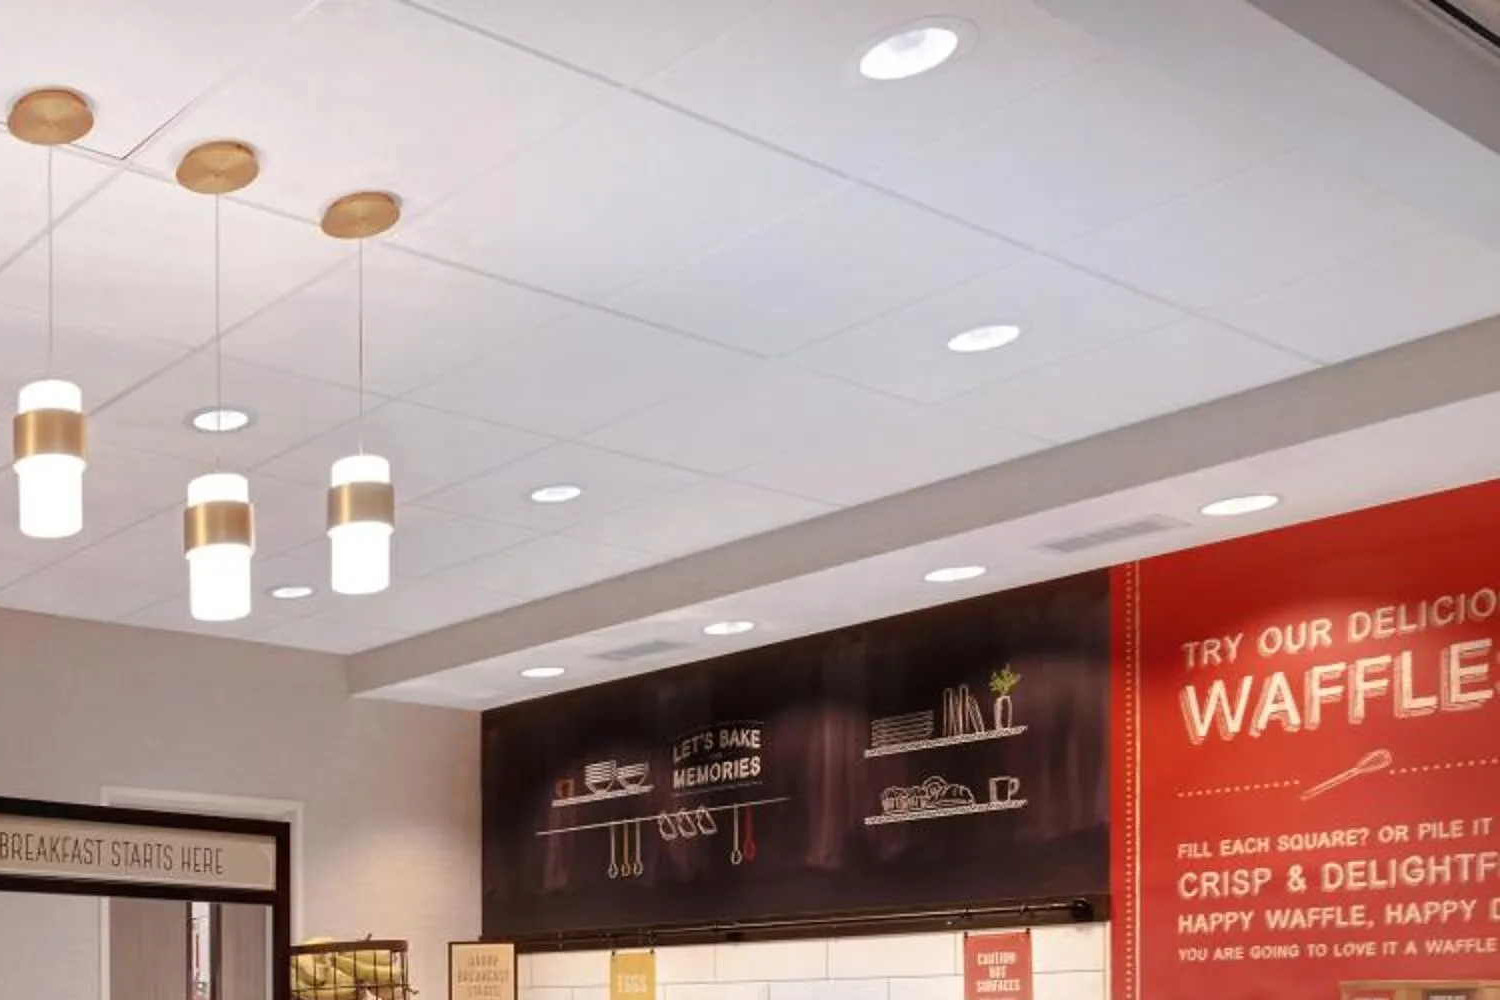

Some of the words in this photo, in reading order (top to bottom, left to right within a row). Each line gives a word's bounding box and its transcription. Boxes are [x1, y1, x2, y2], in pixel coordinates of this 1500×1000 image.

[1182, 632, 1244, 669] TRY
[1257, 618, 1332, 656] OUR
[1348, 587, 1500, 643] DELICIO
[1180, 637, 1500, 745] WAFFLE
[673, 732, 714, 763] LET'S
[720, 728, 761, 749] BAKE
[672, 756, 761, 789] MEMORIES
[0, 831, 105, 866] BREAKFAST
[111, 840, 173, 872] STARTS
[181, 846, 225, 876] HERE
[1178, 843, 1212, 859] FILL
[1220, 837, 1269, 856] EACH
[1277, 828, 1370, 851] SQUARE?
[1378, 824, 1409, 843] OR
[1417, 819, 1464, 840] PILE
[1472, 817, 1493, 836] IT
[1178, 867, 1272, 900] CRISP
[1286, 863, 1308, 894] &
[1321, 851, 1500, 893] DELIGHTF
[1178, 910, 1254, 934] HAPPY
[1265, 904, 1375, 930] WAFFLE,
[1384, 899, 1477, 926] HAPPY
[1179, 948, 1208, 962] YOU
[1213, 947, 1245, 961] ARE
[1250, 945, 1300, 959] GOING
[1307, 943, 1328, 957] TO
[1334, 942, 1376, 957] LOVE
[1382, 941, 1398, 955] IT
[1406, 940, 1418, 955] A
[1425, 937, 1498, 954] WAFFLE
[617, 974, 648, 993] EGGS
